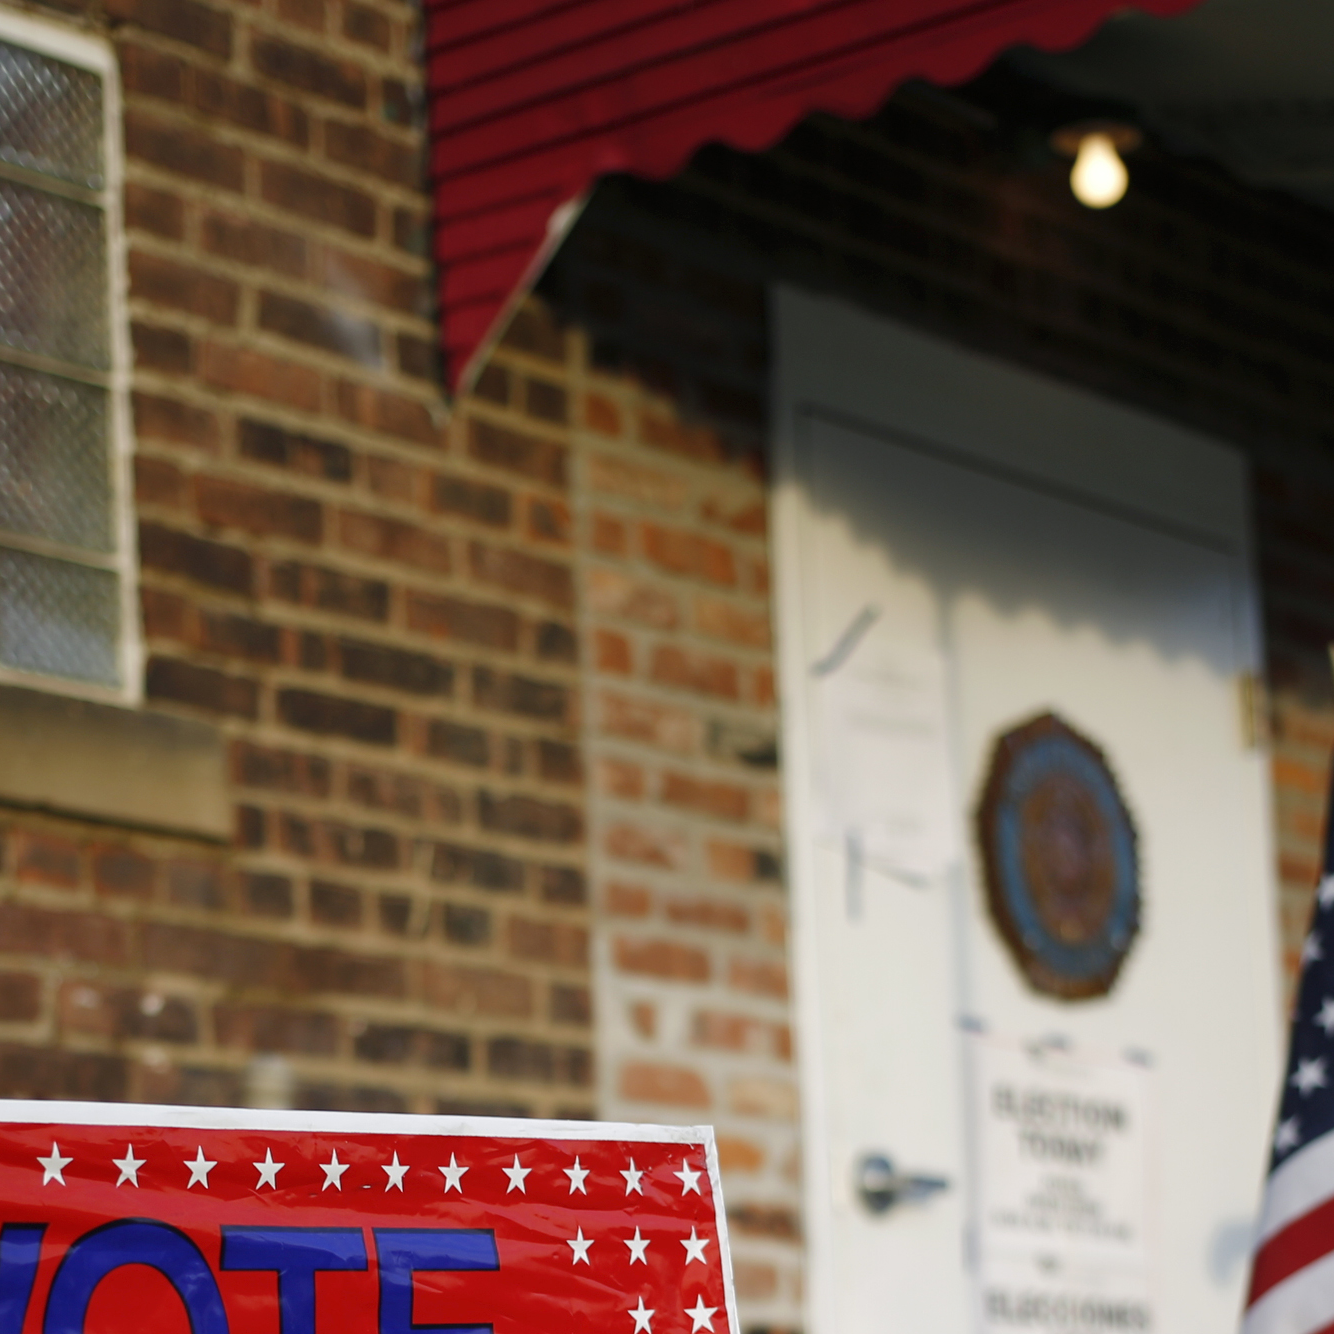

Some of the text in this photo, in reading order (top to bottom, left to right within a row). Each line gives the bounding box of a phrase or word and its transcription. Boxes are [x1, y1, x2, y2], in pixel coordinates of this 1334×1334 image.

[991, 1084, 1128, 1134] ELECTION
[1017, 1128, 1104, 1165] TODAY
[984, 1291, 1151, 1334] ELECCIONES
